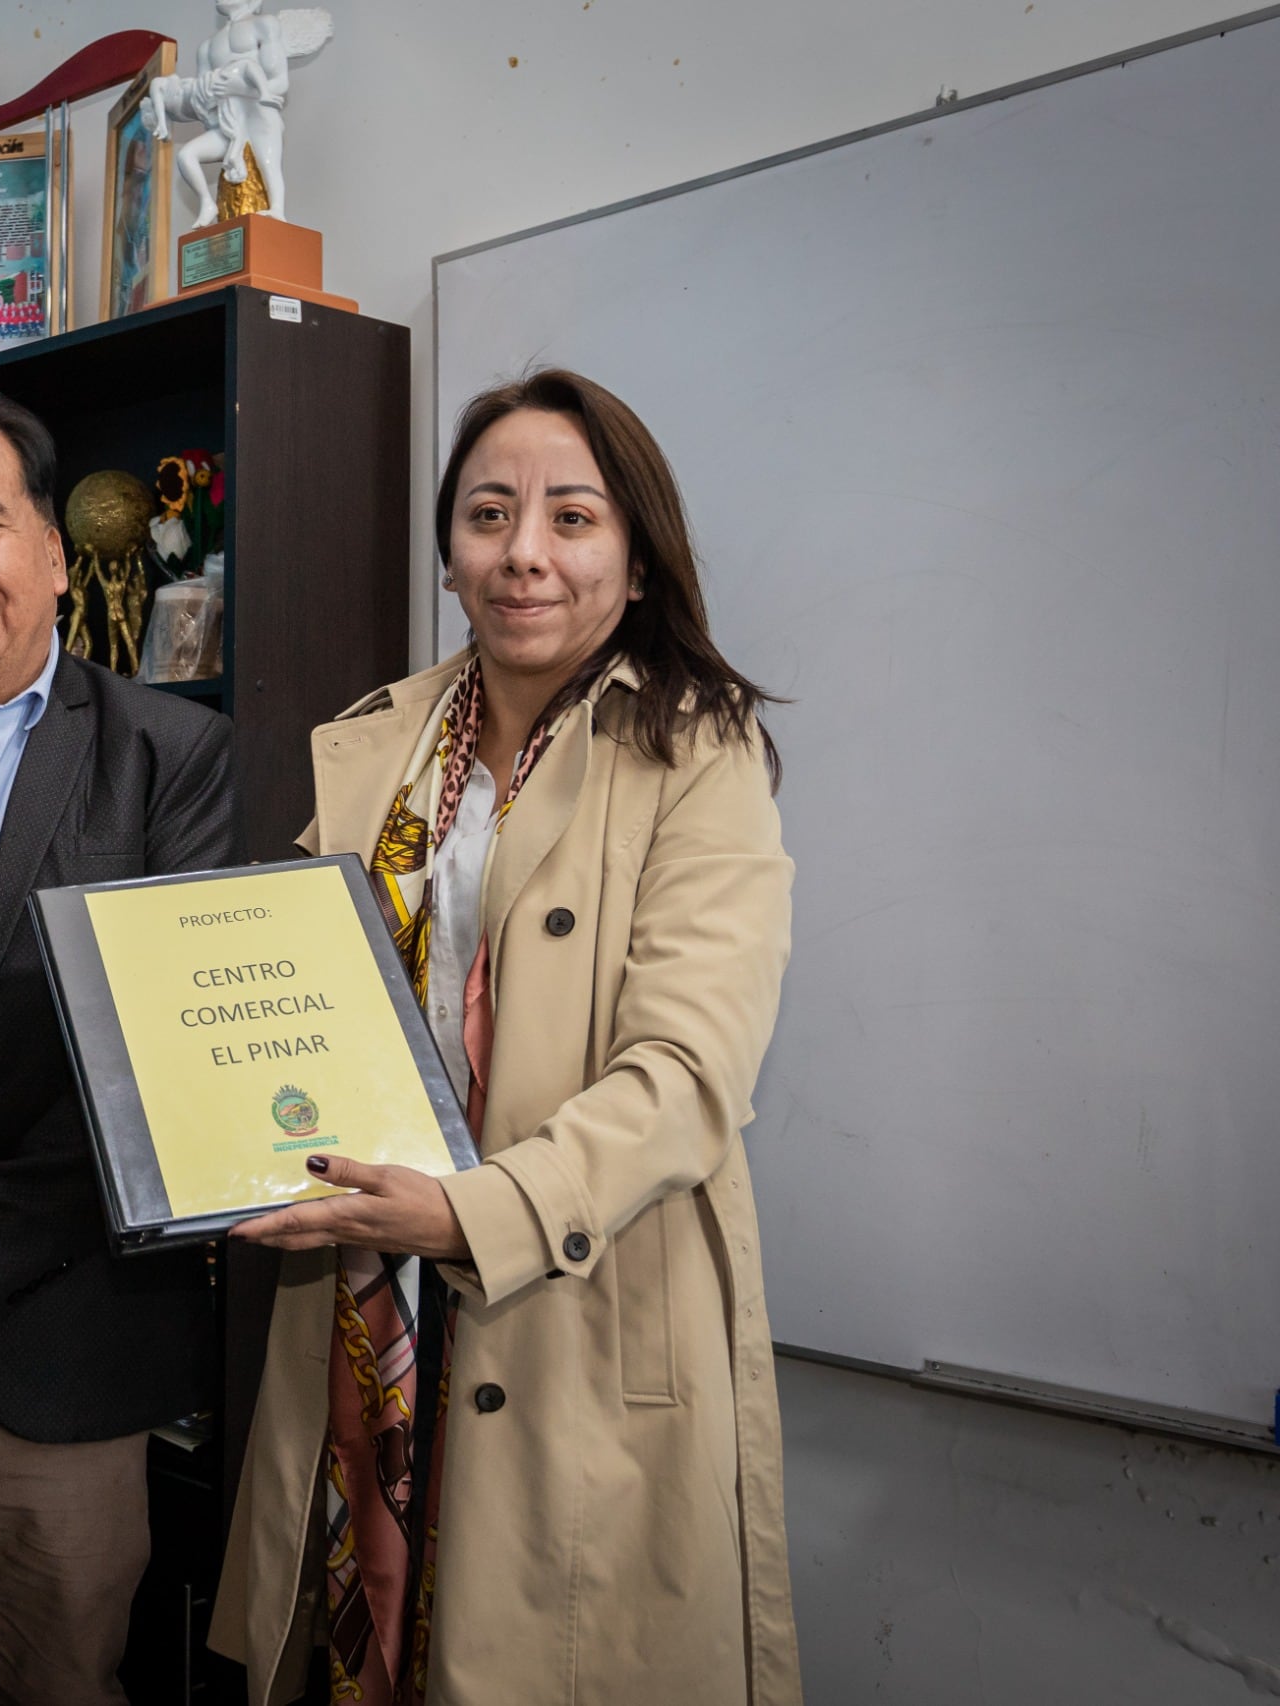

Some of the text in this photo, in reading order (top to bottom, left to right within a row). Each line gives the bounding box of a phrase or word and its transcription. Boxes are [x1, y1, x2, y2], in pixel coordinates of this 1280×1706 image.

[179, 907, 272, 928] PROYECTO:
[193, 960, 296, 988] CENTRO
[180, 993, 335, 1027] COMERCIAL
[211, 1034, 330, 1066] EL PINAR
